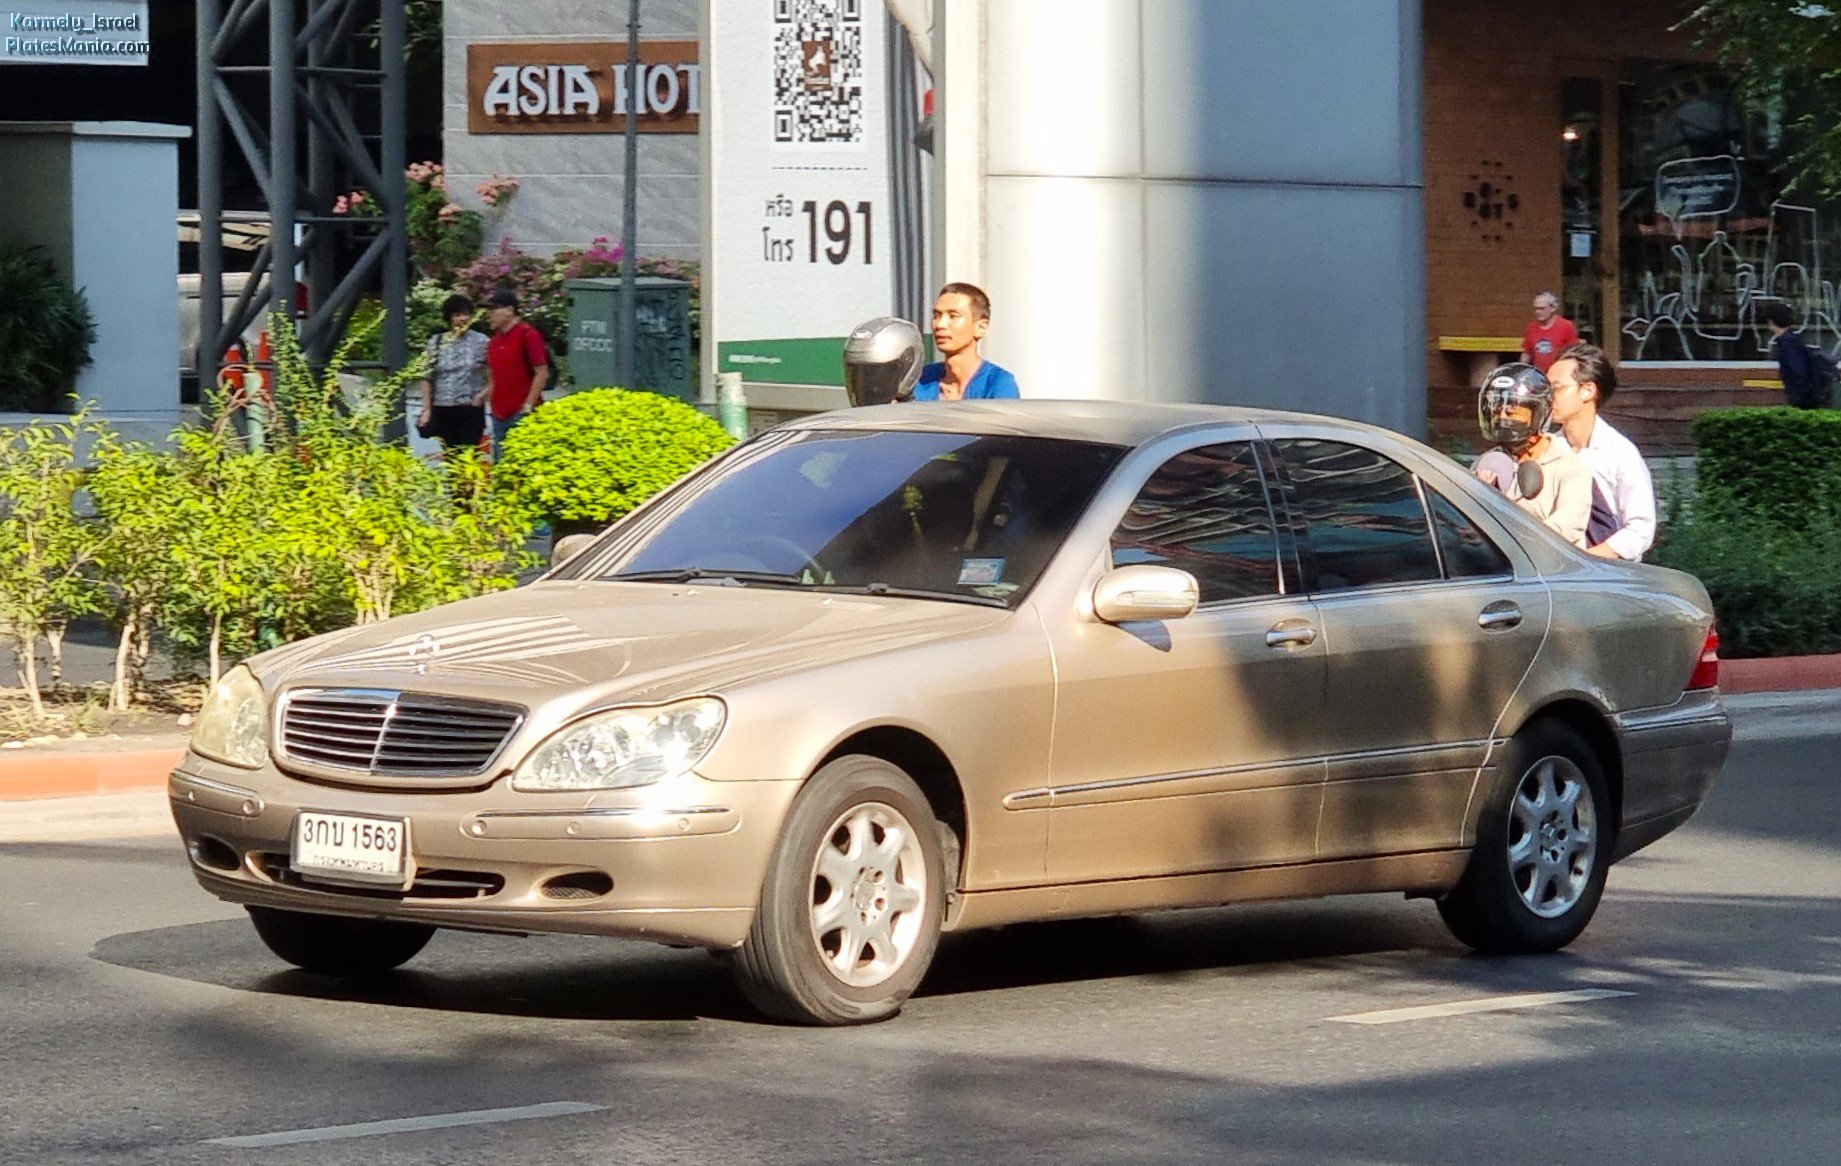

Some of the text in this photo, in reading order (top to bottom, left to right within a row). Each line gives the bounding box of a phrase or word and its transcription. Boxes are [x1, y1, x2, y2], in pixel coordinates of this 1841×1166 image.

[483, 64, 599, 115] ASIA
[762, 200, 872, 265] โทร 191
[352, 823, 397, 851] 1563
